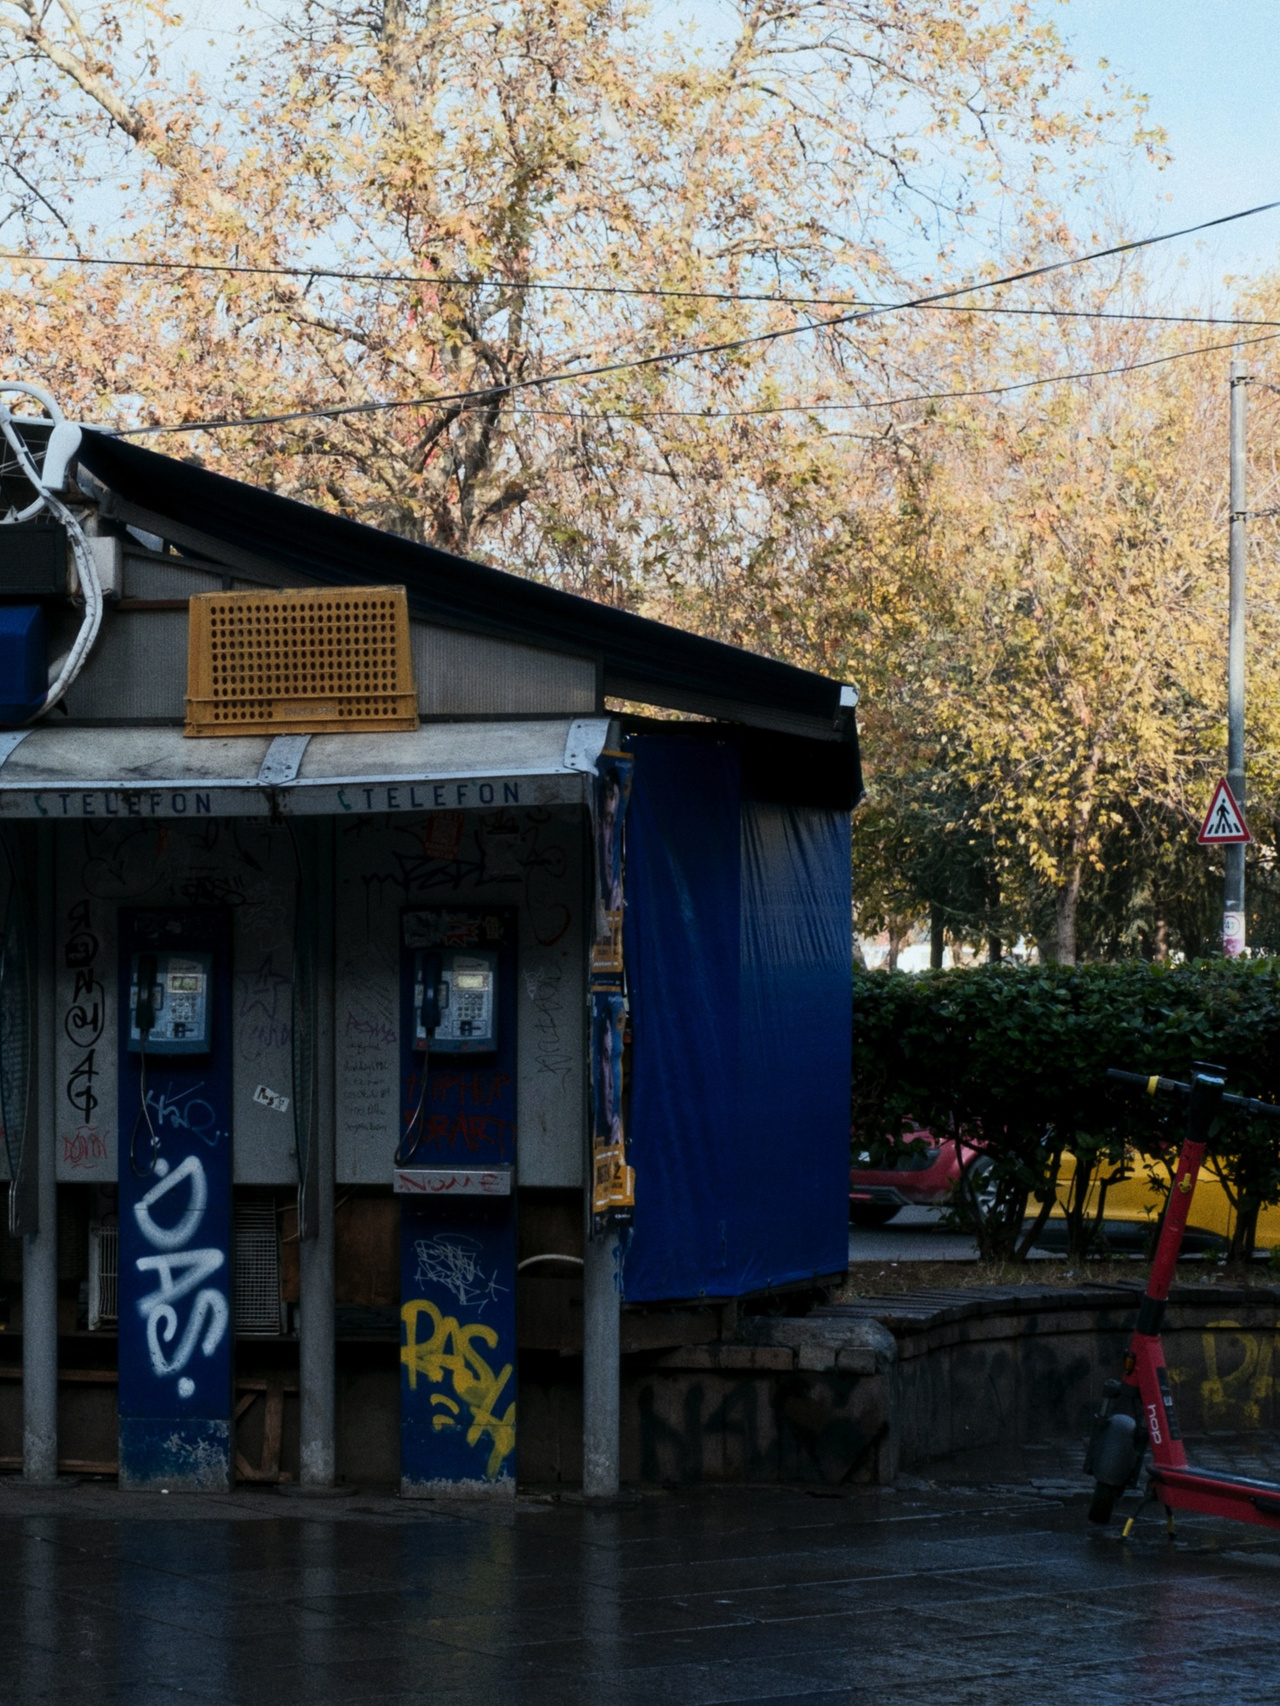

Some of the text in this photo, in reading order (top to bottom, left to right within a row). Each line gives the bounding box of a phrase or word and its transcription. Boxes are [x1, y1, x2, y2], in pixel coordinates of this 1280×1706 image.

[58, 792, 212, 815] TELEFON
[362, 782, 519, 809] TELEFON
[1147, 1403, 1163, 1445] hop
